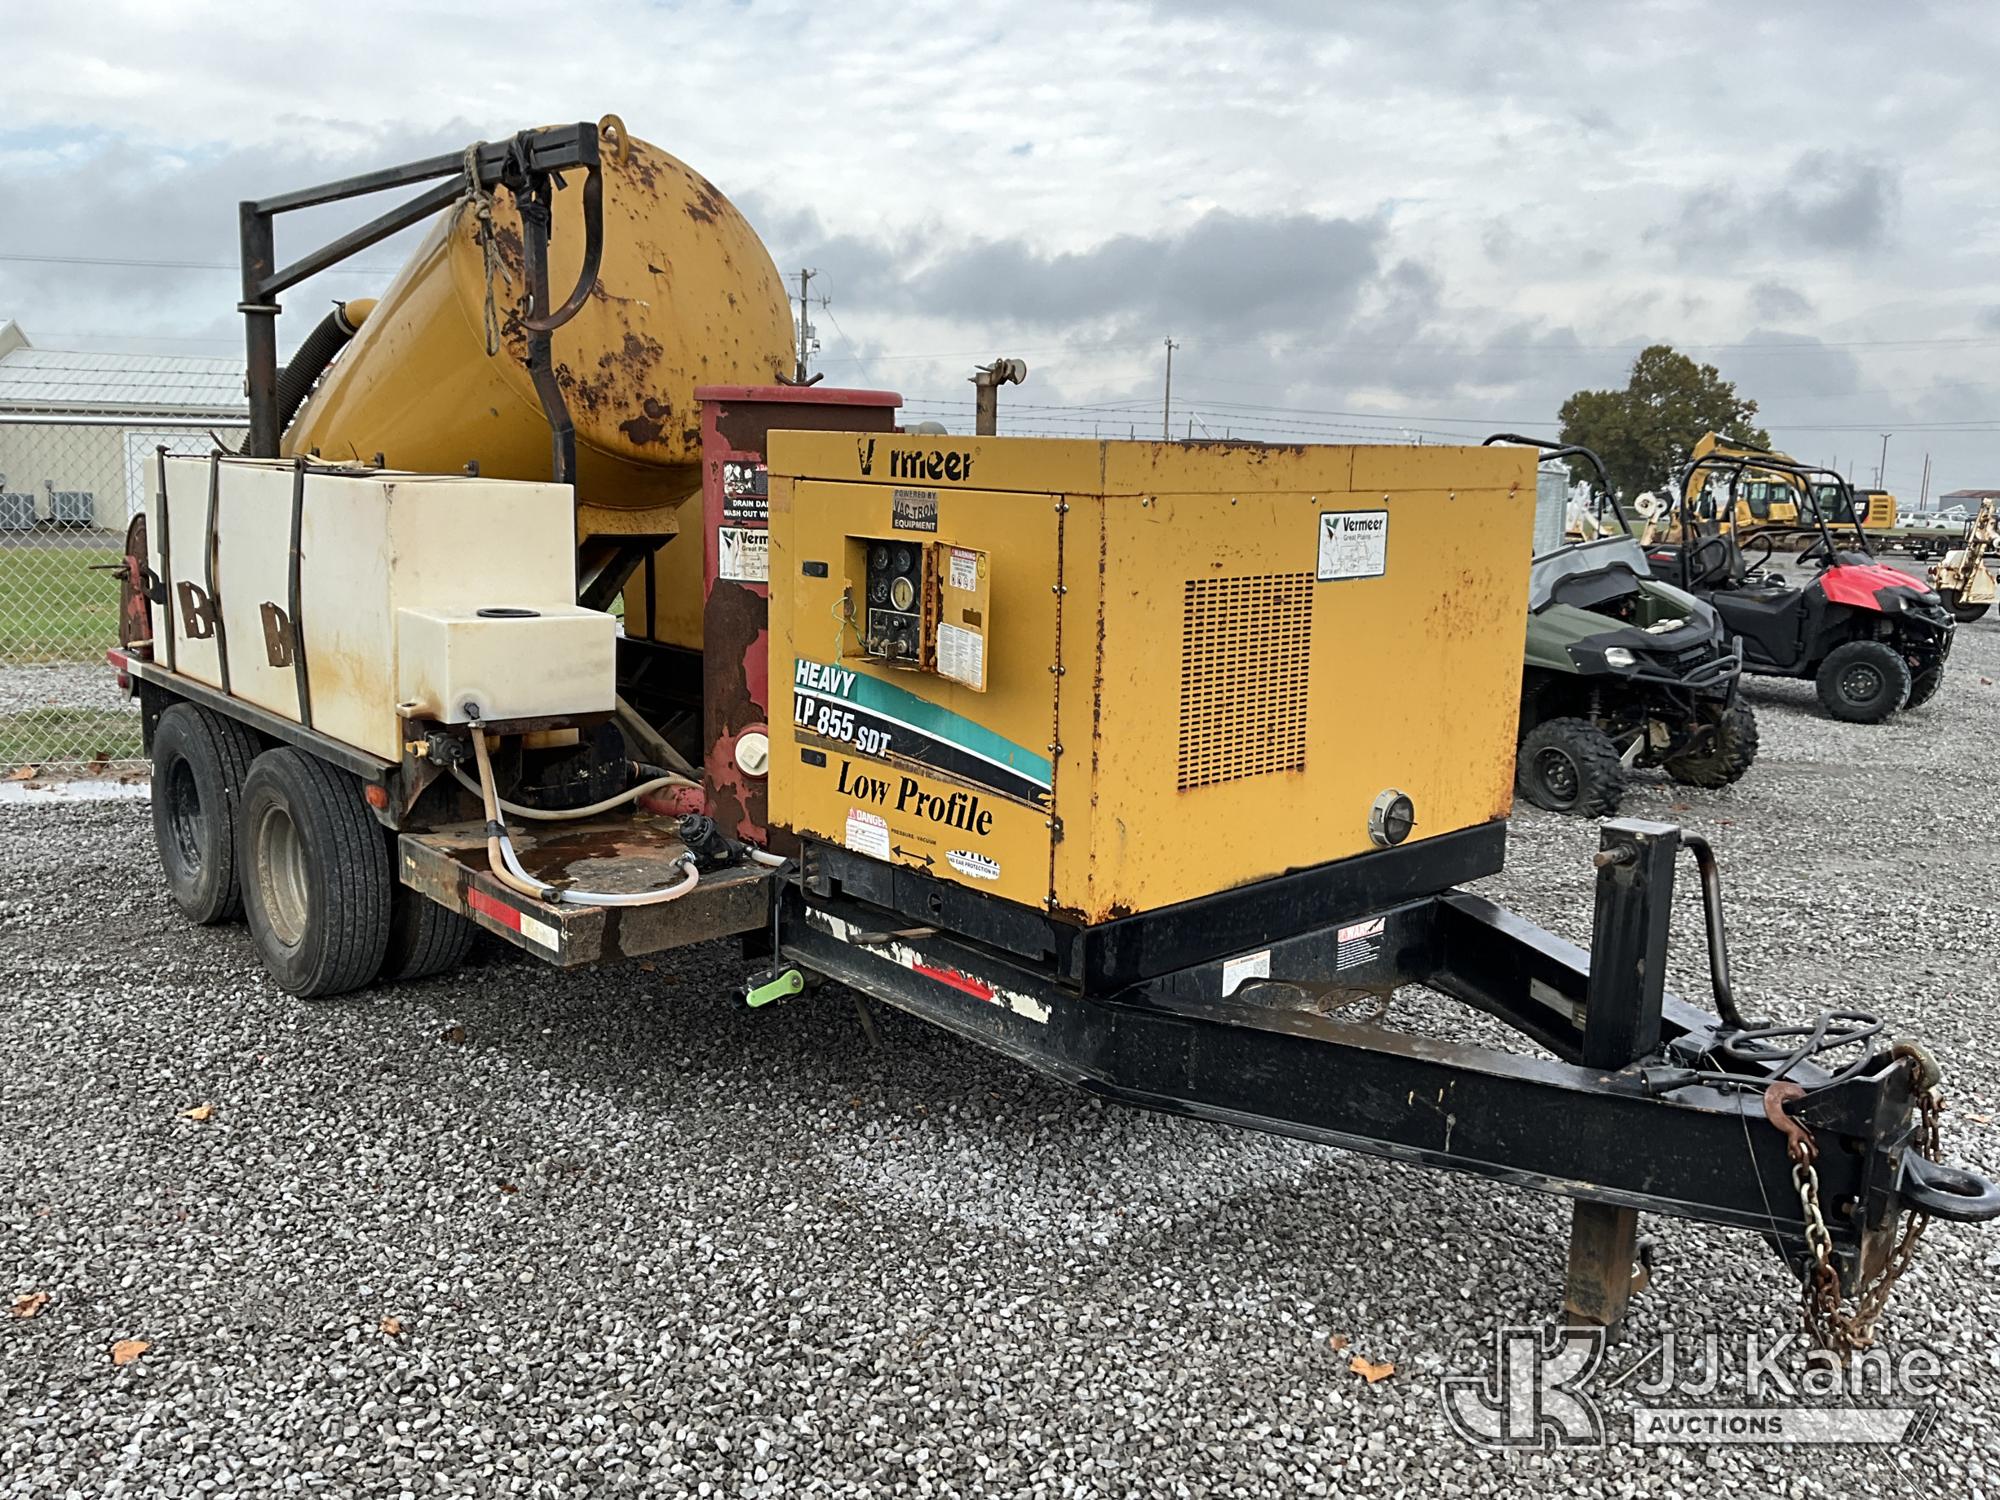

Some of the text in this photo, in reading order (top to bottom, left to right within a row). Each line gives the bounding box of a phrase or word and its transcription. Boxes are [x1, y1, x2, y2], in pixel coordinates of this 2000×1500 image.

[857, 438, 974, 481] Vrmeer
[895, 489, 936, 499] POWERED BY
[733, 500, 754, 508] DRAIN
[723, 509, 741, 517] WASH
[742, 510, 757, 518] OUT
[894, 519, 936, 530] EQUIPMENT
[1343, 516, 1383, 532] Vermeer
[795, 659, 856, 698] HEAVY
[794, 695, 892, 758] LP 855 SDT
[835, 760, 993, 836] Low Profile
[964, 861, 992, 874] PROTECTION
